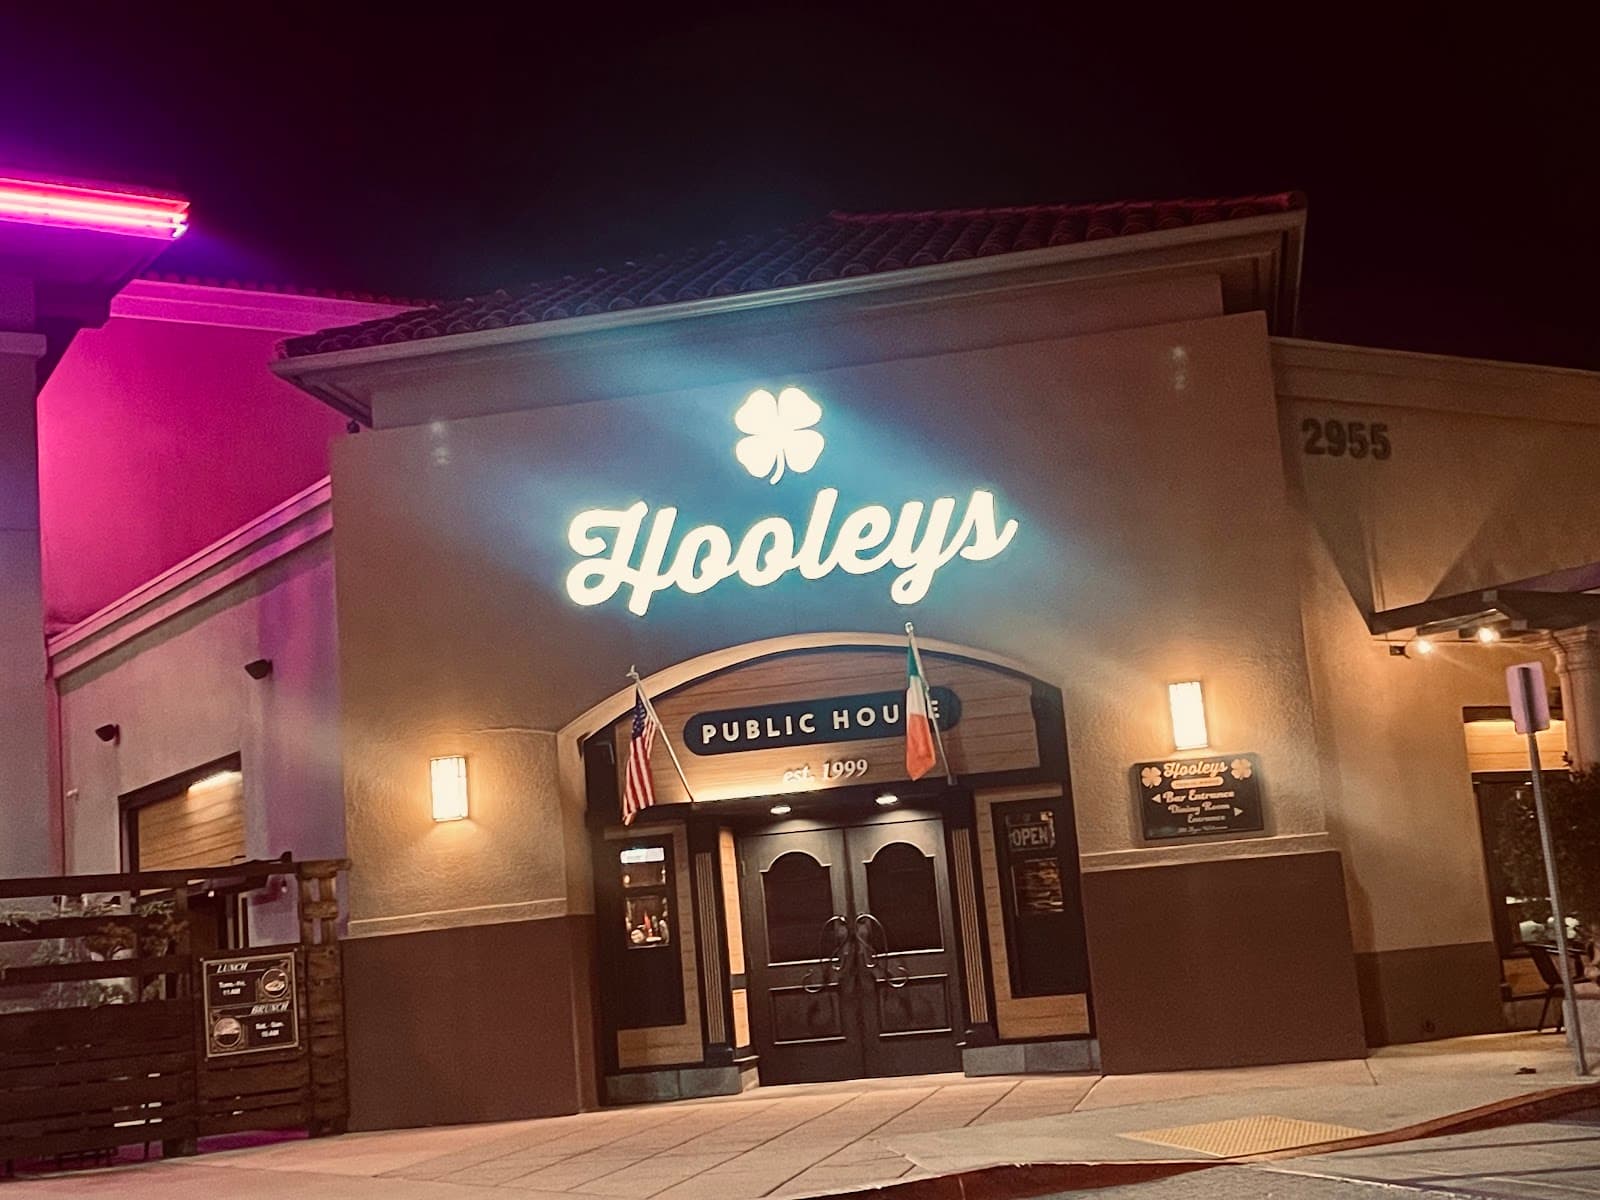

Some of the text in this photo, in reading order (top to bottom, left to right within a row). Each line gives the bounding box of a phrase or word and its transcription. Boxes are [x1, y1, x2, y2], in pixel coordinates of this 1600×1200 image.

[1302, 418, 1392, 460] 2955
[566, 488, 1018, 616] Hooleys
[702, 700, 940, 744] PUBLIC HOUE
[822, 759, 869, 780] 1999
[1163, 761, 1228, 779] Hooleys
[1163, 789, 1234, 803] Bar Entrance
[1012, 827, 1048, 846] OPEN
[217, 962, 248, 973] LUNCH
[251, 1001, 290, 1016] BRUNCH
